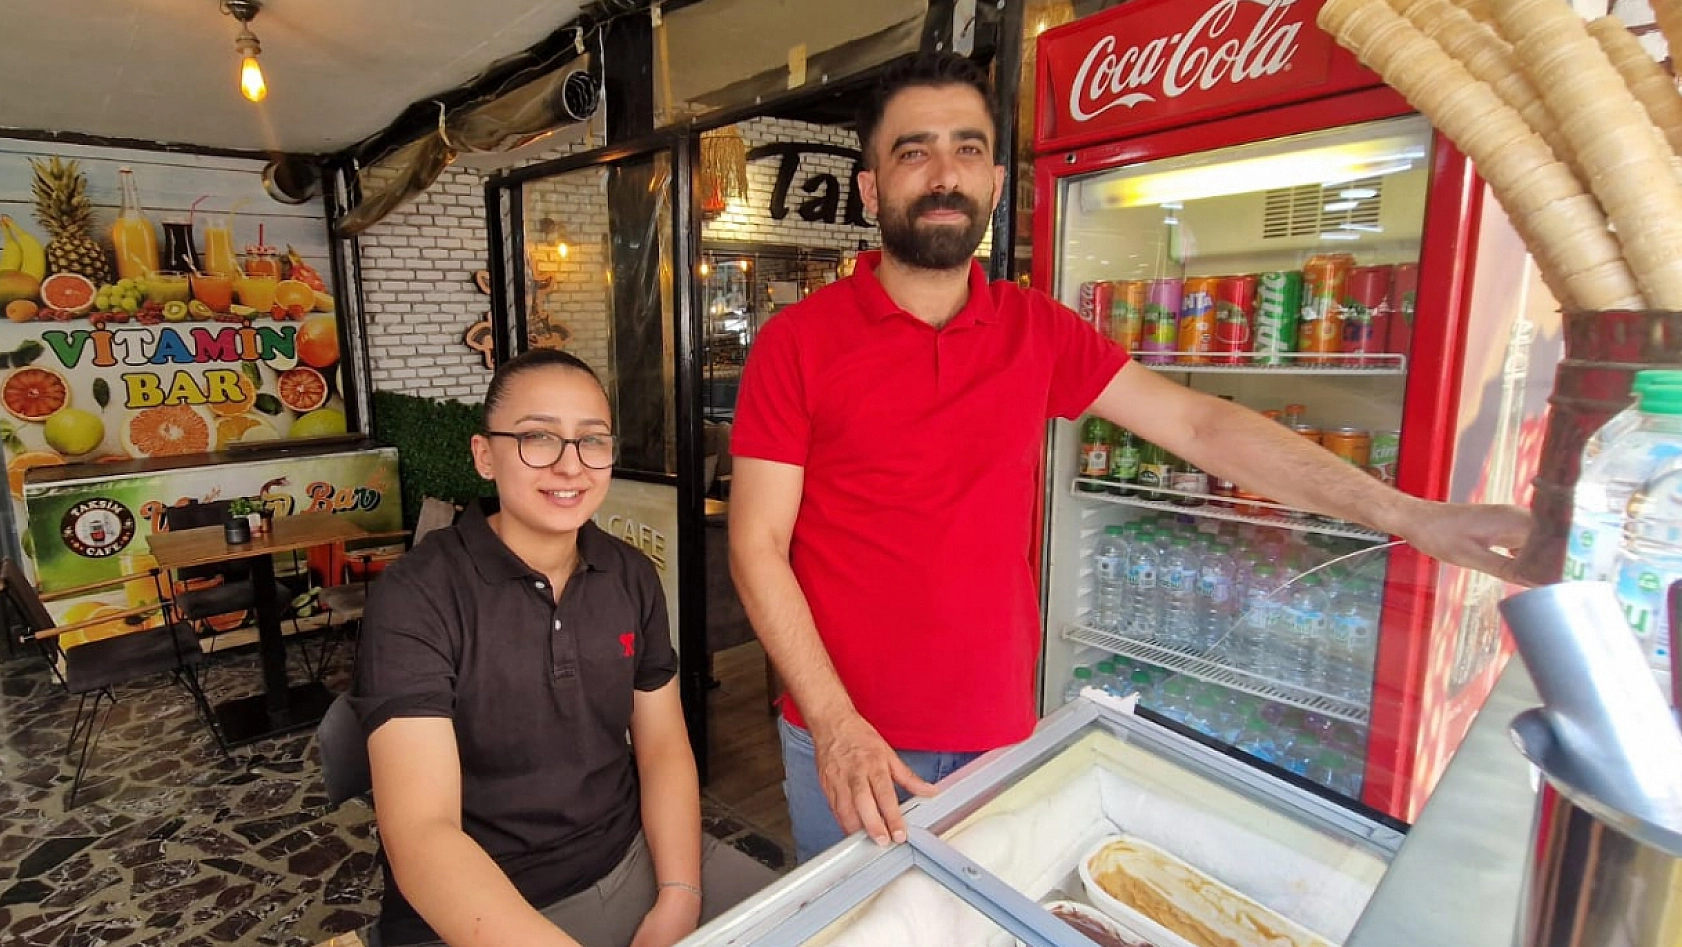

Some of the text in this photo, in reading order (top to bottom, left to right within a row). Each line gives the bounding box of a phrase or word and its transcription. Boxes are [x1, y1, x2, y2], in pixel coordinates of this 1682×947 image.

[1069, 0, 1303, 121] Coca-Cola
[43, 319, 297, 369] VİTAMİN
[121, 369, 246, 409] BAR
